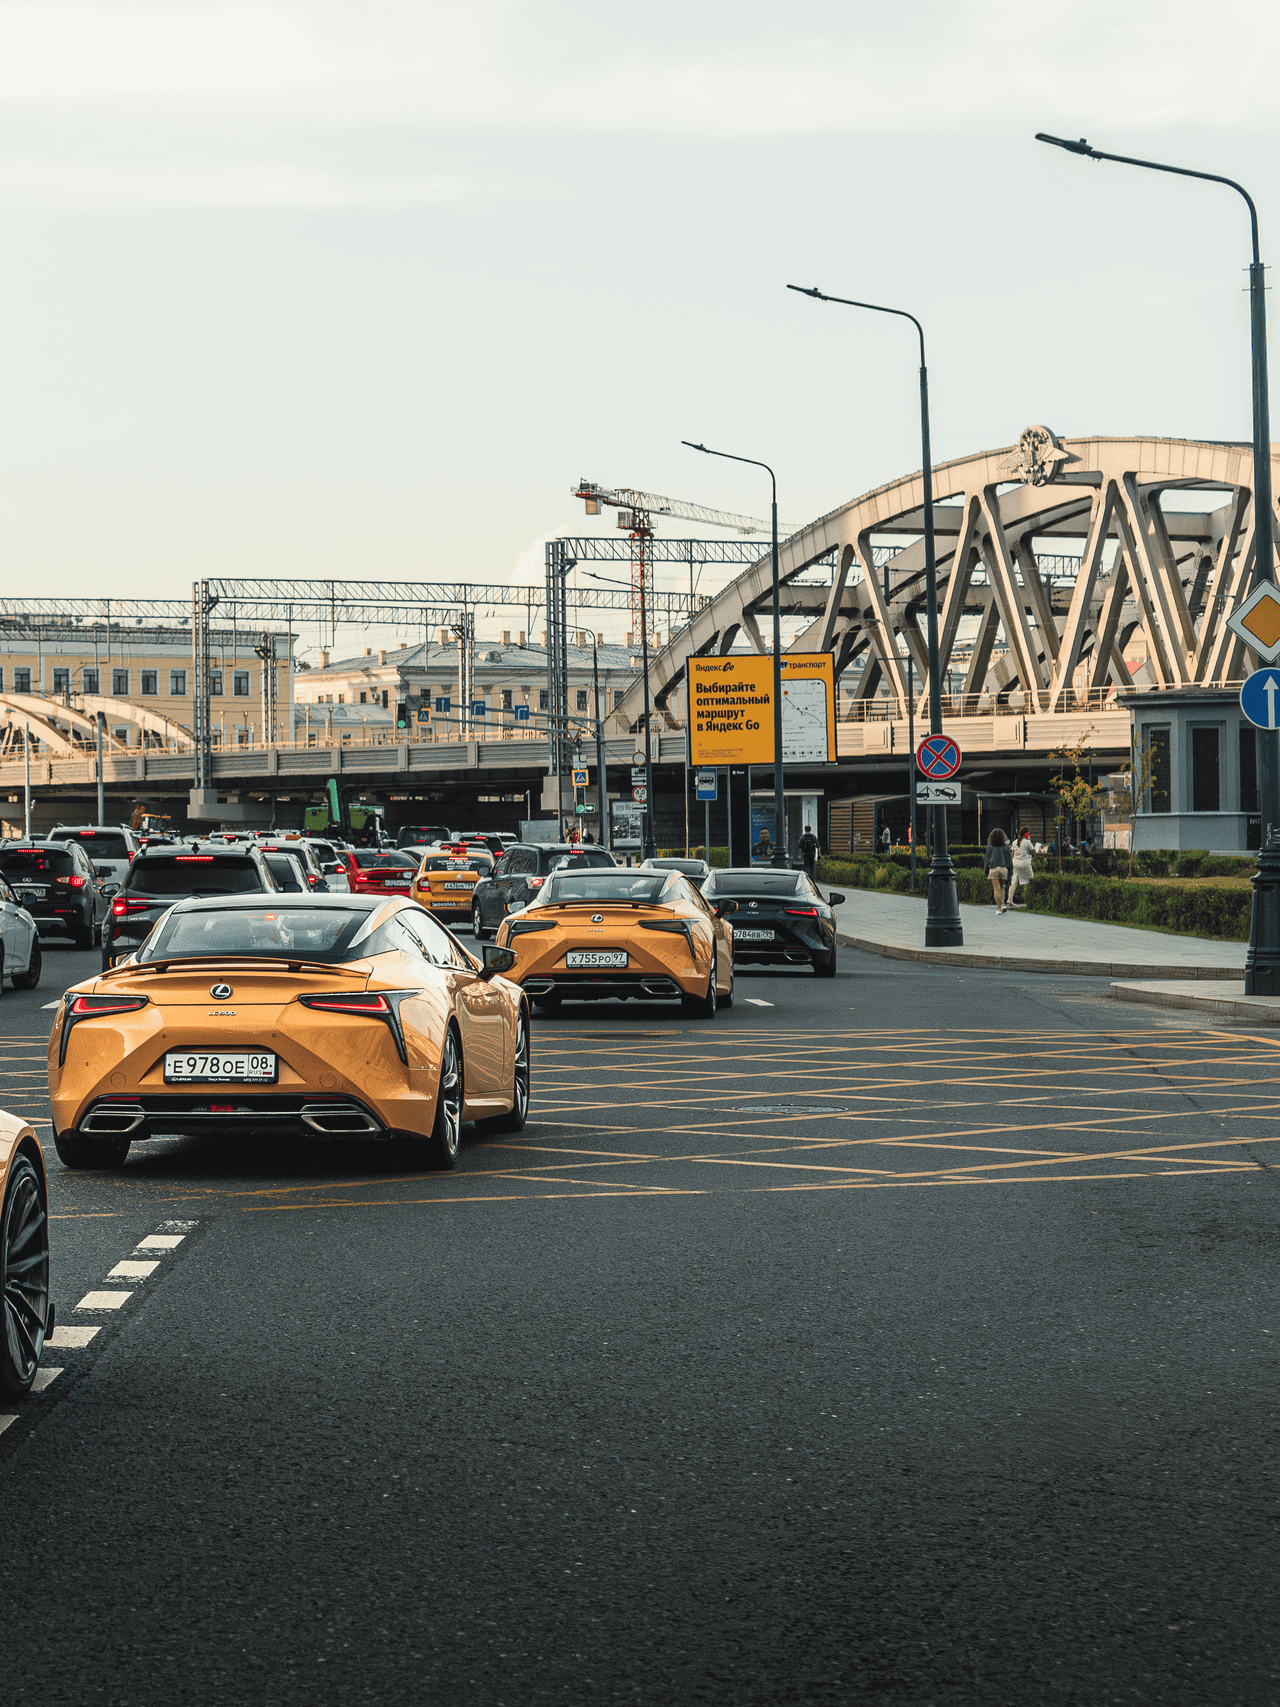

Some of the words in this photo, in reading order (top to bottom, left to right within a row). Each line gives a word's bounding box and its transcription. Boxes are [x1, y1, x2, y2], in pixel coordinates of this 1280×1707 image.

[695, 663, 722, 672] Яндекс
[788, 661, 827, 670] транспорт
[696, 682, 756, 695] Выбирайте
[696, 694, 770, 706] оптимальный
[696, 708, 745, 721] маршрут
[696, 723, 704, 732] в
[705, 720, 743, 733] Яндекс
[745, 719, 760, 731] Go
[571, 953, 611, 963] Х755РО
[613, 953, 624, 961] 97
[173, 1056, 245, 1074] Е978ОЕ
[250, 1056, 269, 1070] 08
